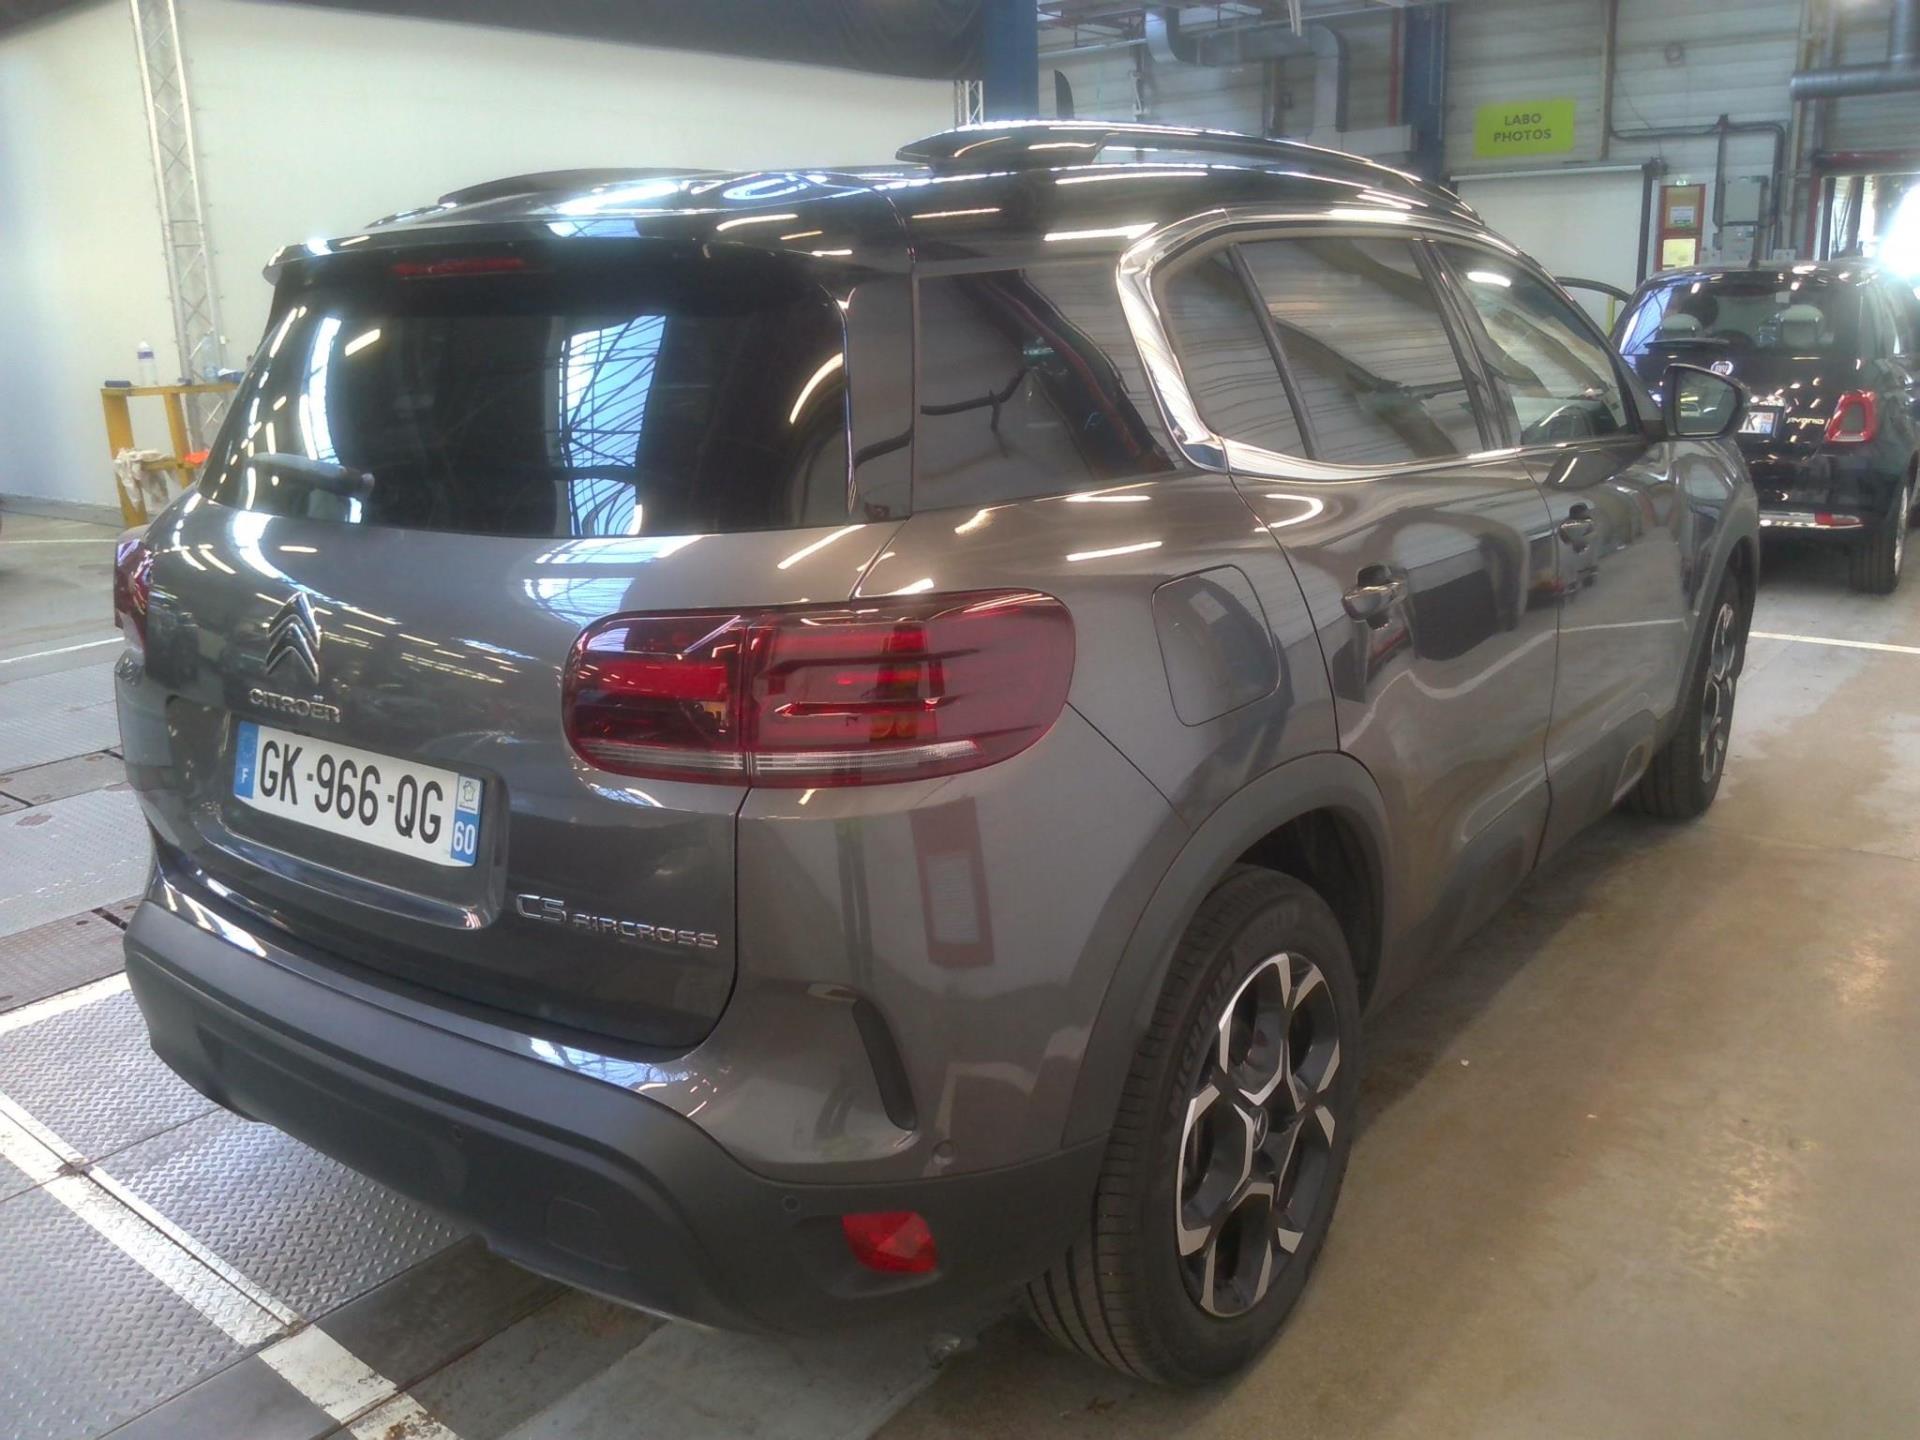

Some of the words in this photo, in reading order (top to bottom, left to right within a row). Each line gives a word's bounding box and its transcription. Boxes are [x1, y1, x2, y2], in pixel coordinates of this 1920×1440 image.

[1504, 113, 1542, 126] LABO
[1493, 128, 1552, 142] PHOTOS
[240, 767, 249, 784] F
[259, 740, 444, 844] GK-966-QG
[453, 820, 476, 855] 60
[516, 893, 567, 922] C5
[573, 913, 719, 949] AIRCROSS
